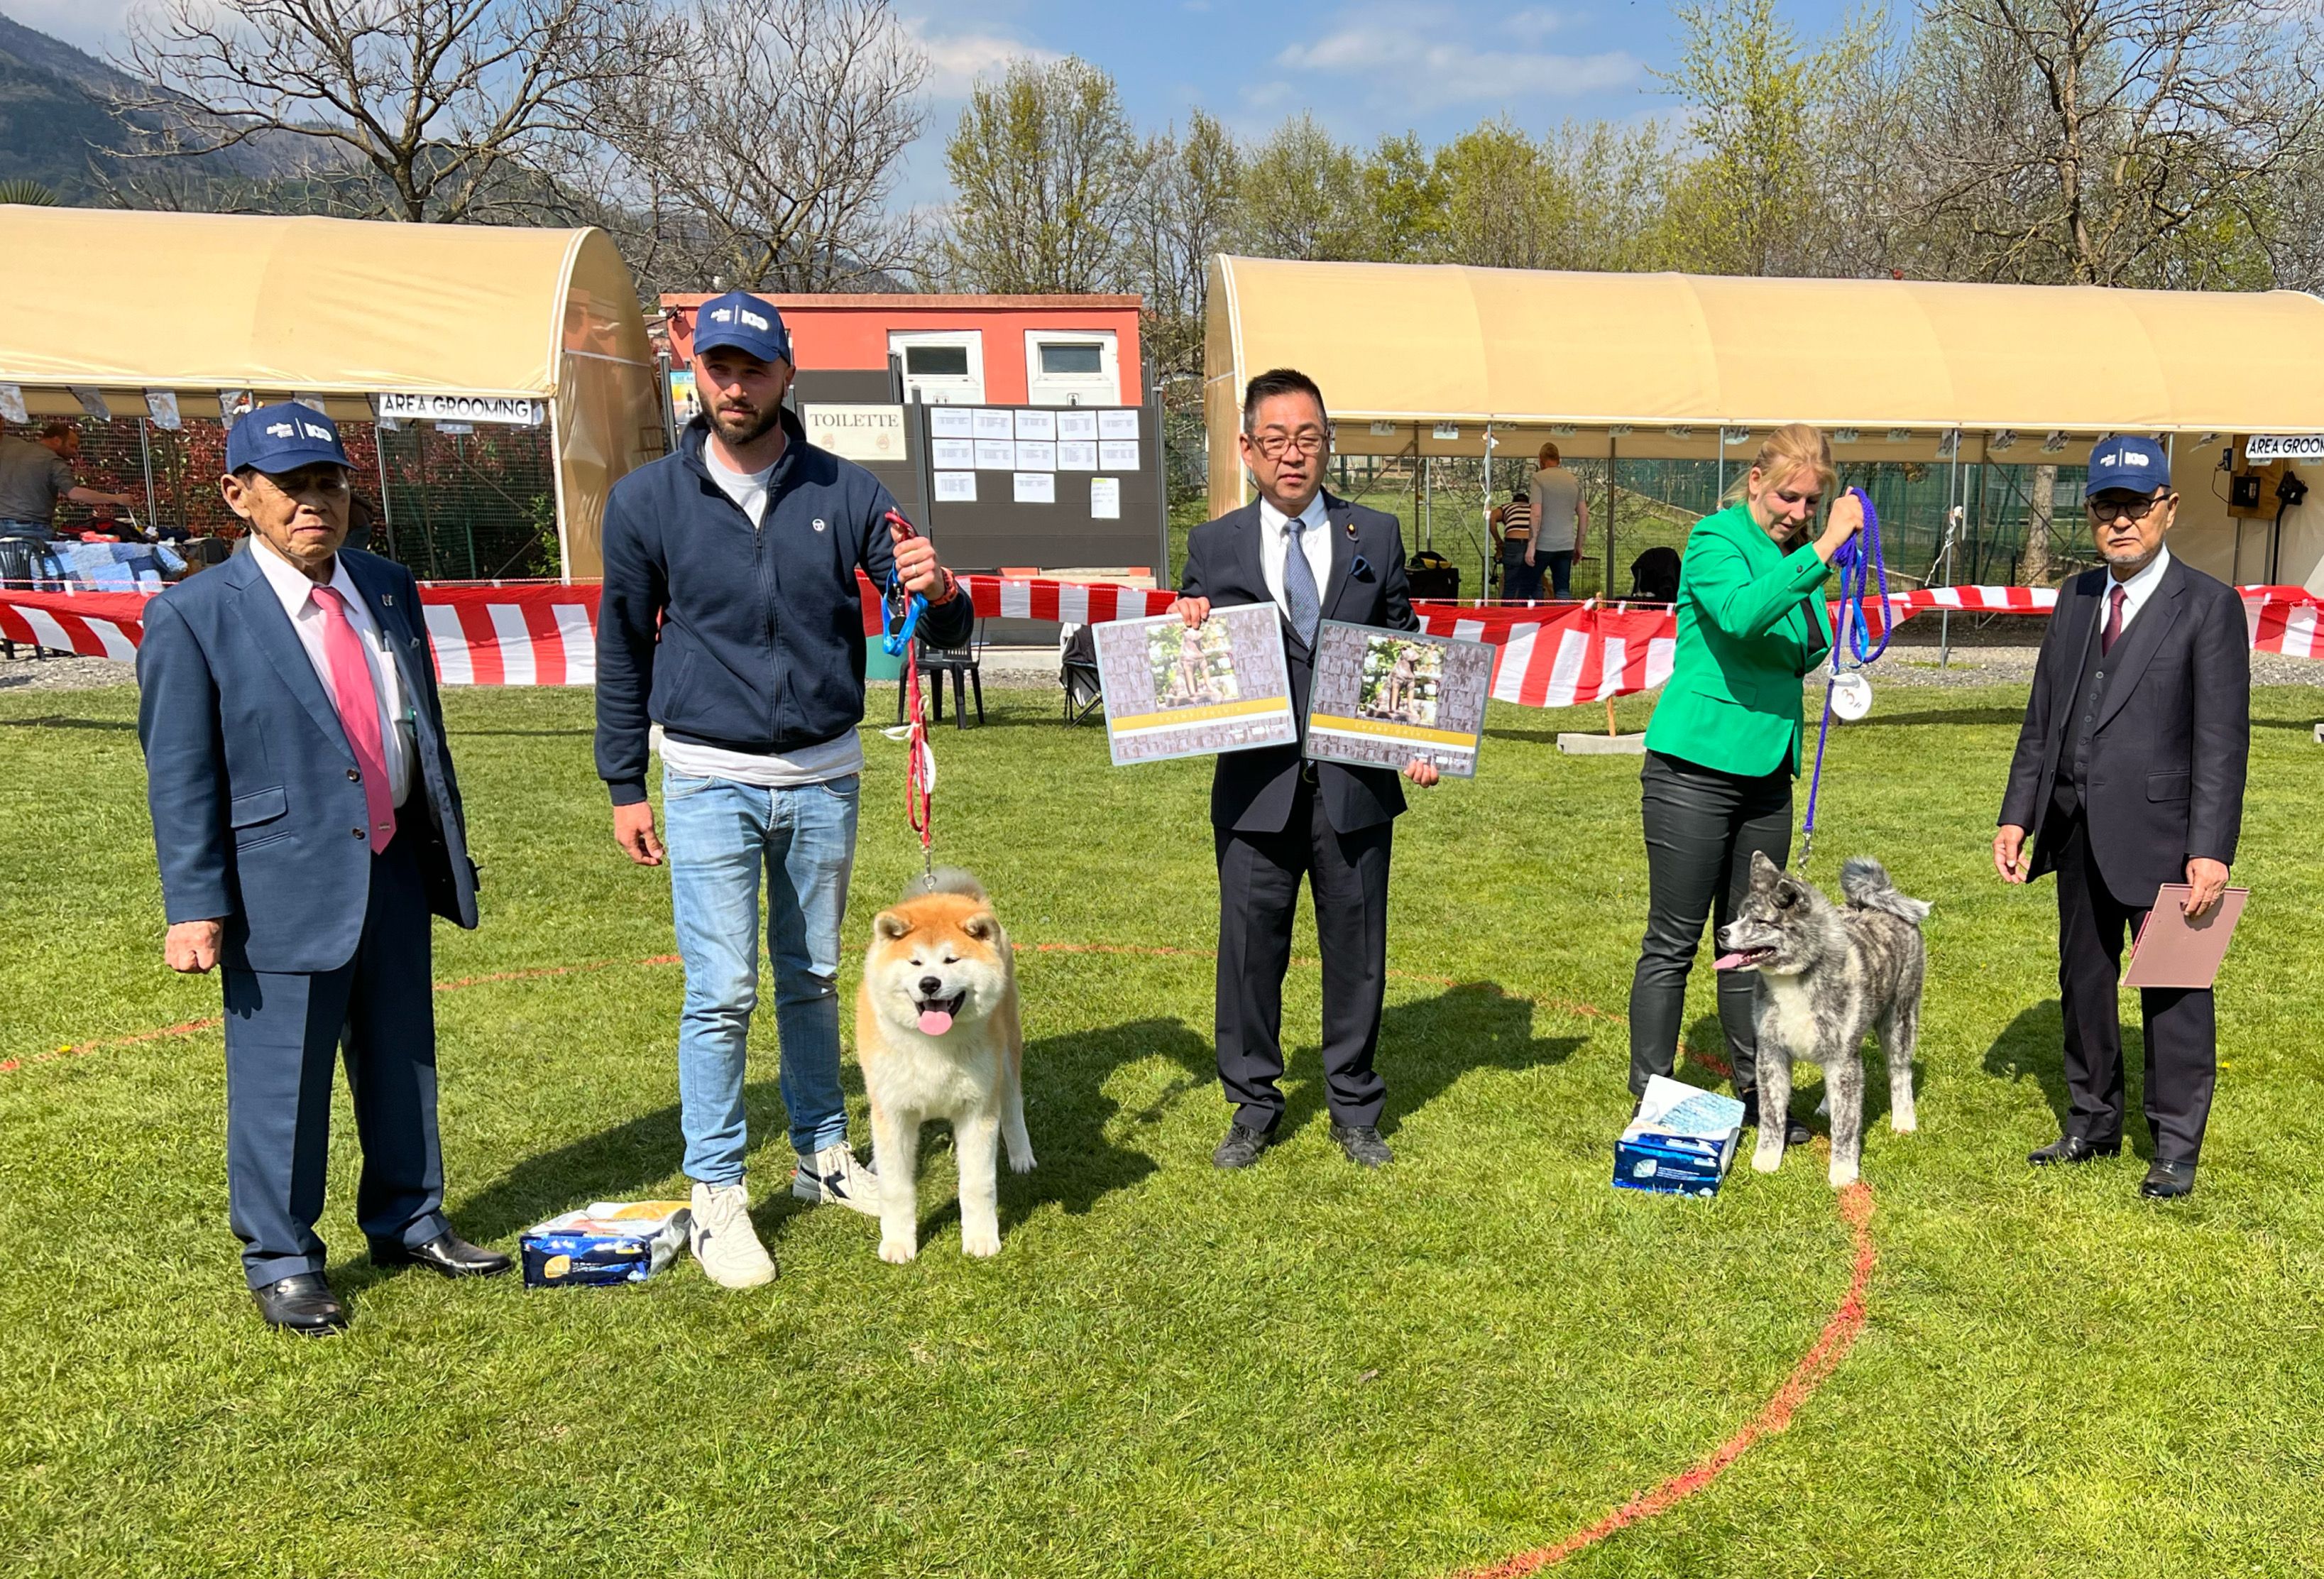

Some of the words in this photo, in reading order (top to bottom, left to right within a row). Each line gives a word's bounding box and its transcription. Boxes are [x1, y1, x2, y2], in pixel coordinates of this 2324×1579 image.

[384, 393, 427, 414] AREA
[432, 395, 529, 419] GROOMING
[809, 413, 899, 427] TOILETTE
[2248, 438, 2279, 454] AREA
